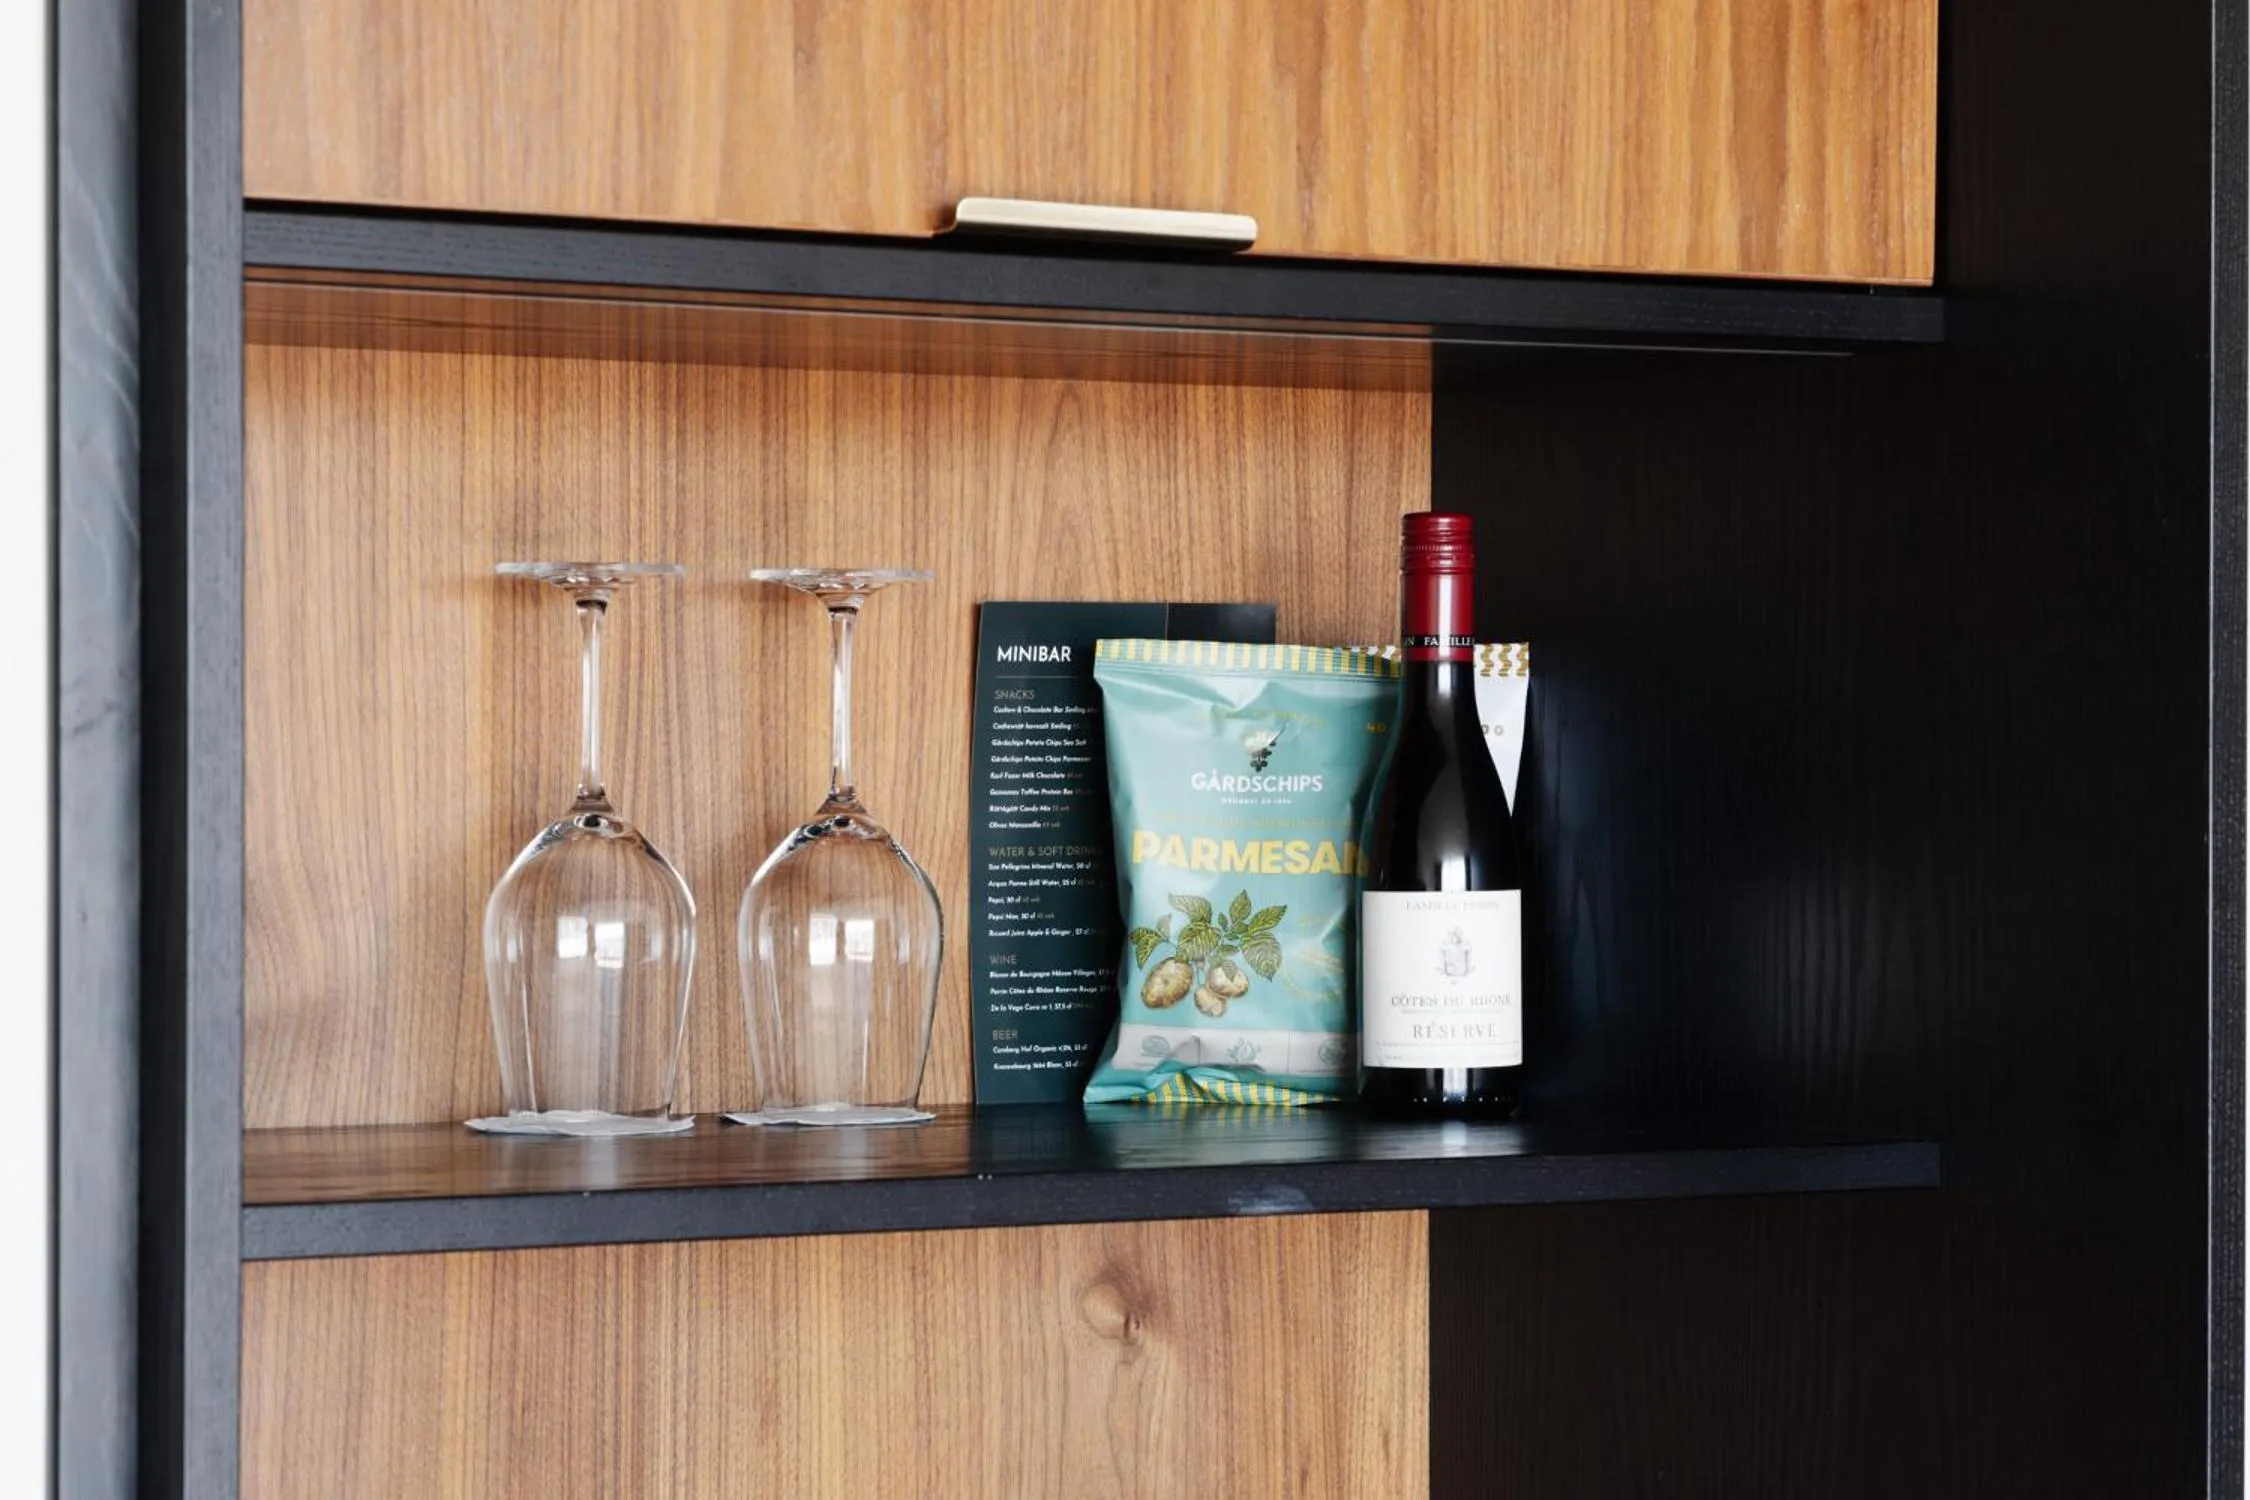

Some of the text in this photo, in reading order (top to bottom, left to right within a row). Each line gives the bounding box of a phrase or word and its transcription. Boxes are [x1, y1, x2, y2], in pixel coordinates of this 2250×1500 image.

[997, 645, 1071, 662] MINIBAR
[994, 690, 1035, 700] SNACKS
[1191, 769, 1323, 792] GÅRDSCHIPS
[989, 846, 1025, 857] WATER
[1027, 846, 1034, 857] &
[1038, 846, 1063, 857] SOFT
[1132, 829, 1367, 877] PARMESAN
[989, 955, 1017, 965] WINE
[992, 1029, 1018, 1040] BEER
